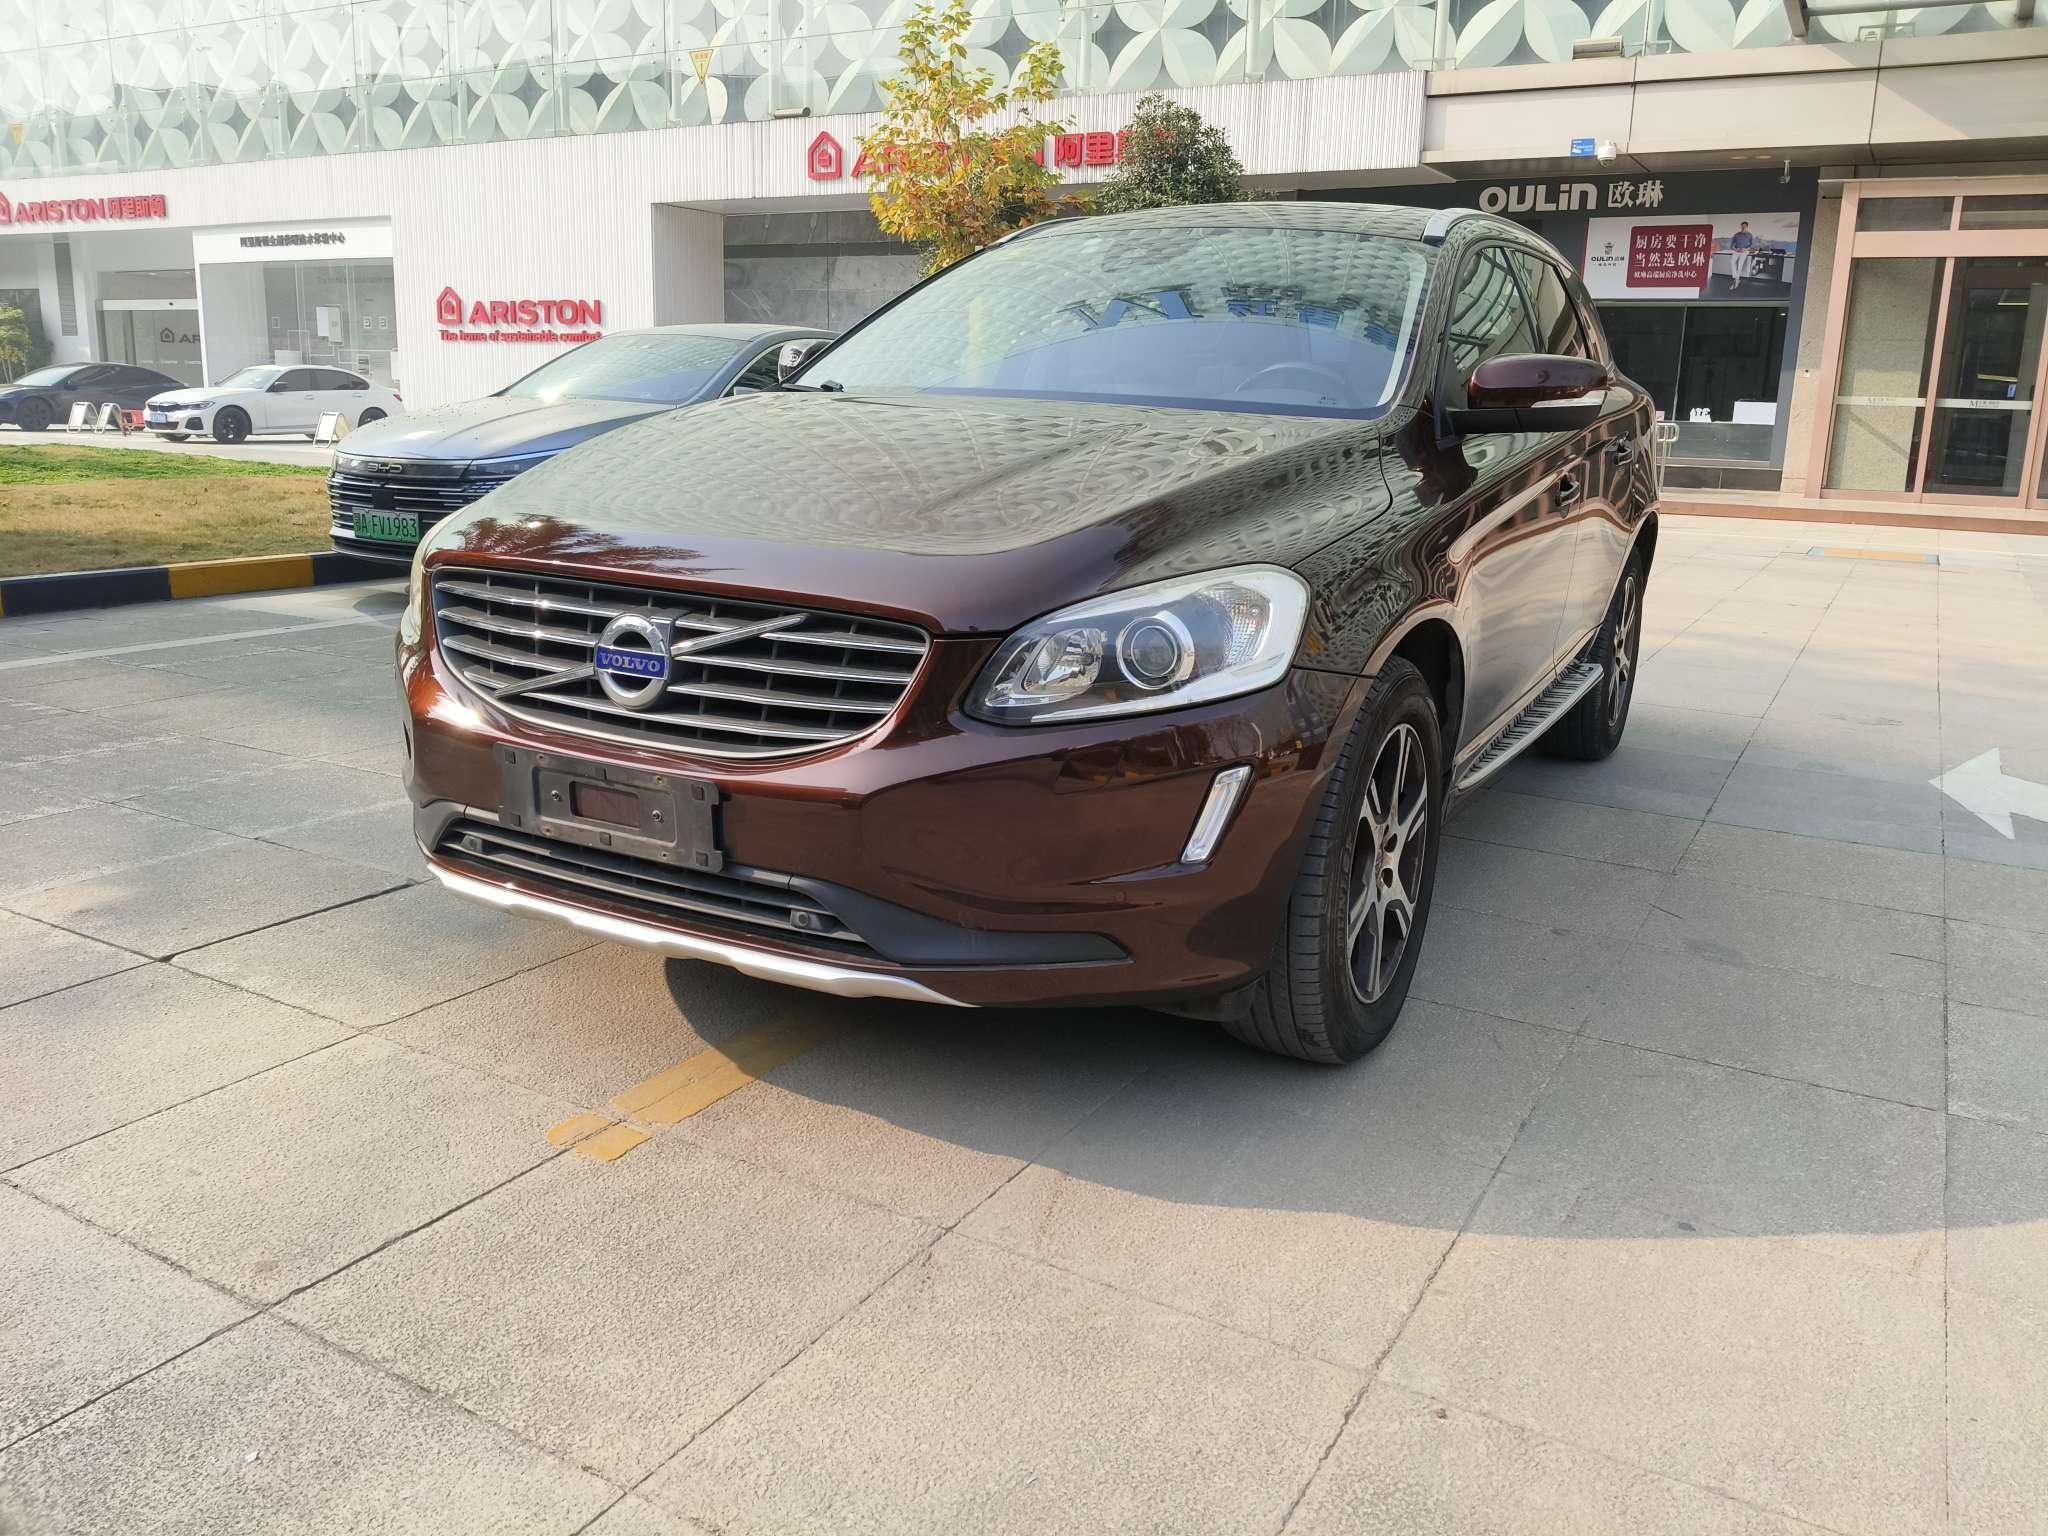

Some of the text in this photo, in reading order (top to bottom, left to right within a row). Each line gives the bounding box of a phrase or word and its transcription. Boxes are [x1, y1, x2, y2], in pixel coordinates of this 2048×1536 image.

[1607, 180, 1664, 208] 欧琳
[15, 194, 167, 223] ARISTON 阿里斯顿
[1635, 233, 1706, 249] 厨房要干净
[1634, 251, 1706, 267] 当然选欧琳
[468, 299, 602, 325] ARISTON
[439, 329, 458, 341] The
[460, 329, 487, 341] home
[489, 329, 501, 341] of
[367, 462, 403, 473] BYD
[599, 652, 661, 673] VOLVO
